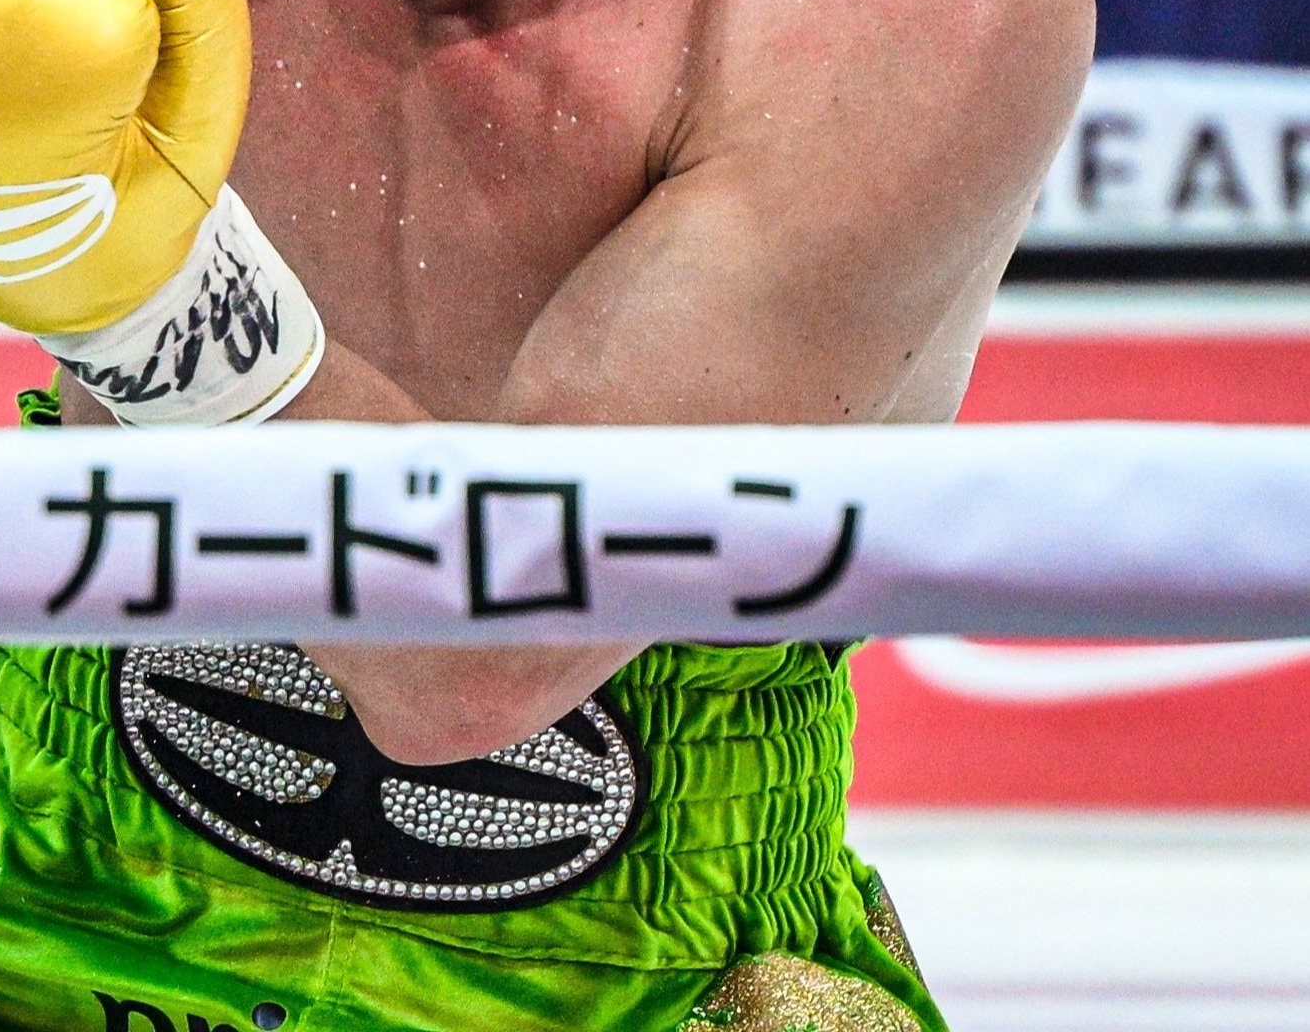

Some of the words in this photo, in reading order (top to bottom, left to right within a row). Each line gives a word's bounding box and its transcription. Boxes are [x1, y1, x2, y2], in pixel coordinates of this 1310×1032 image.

[44, 467, 863, 619] カードローン
